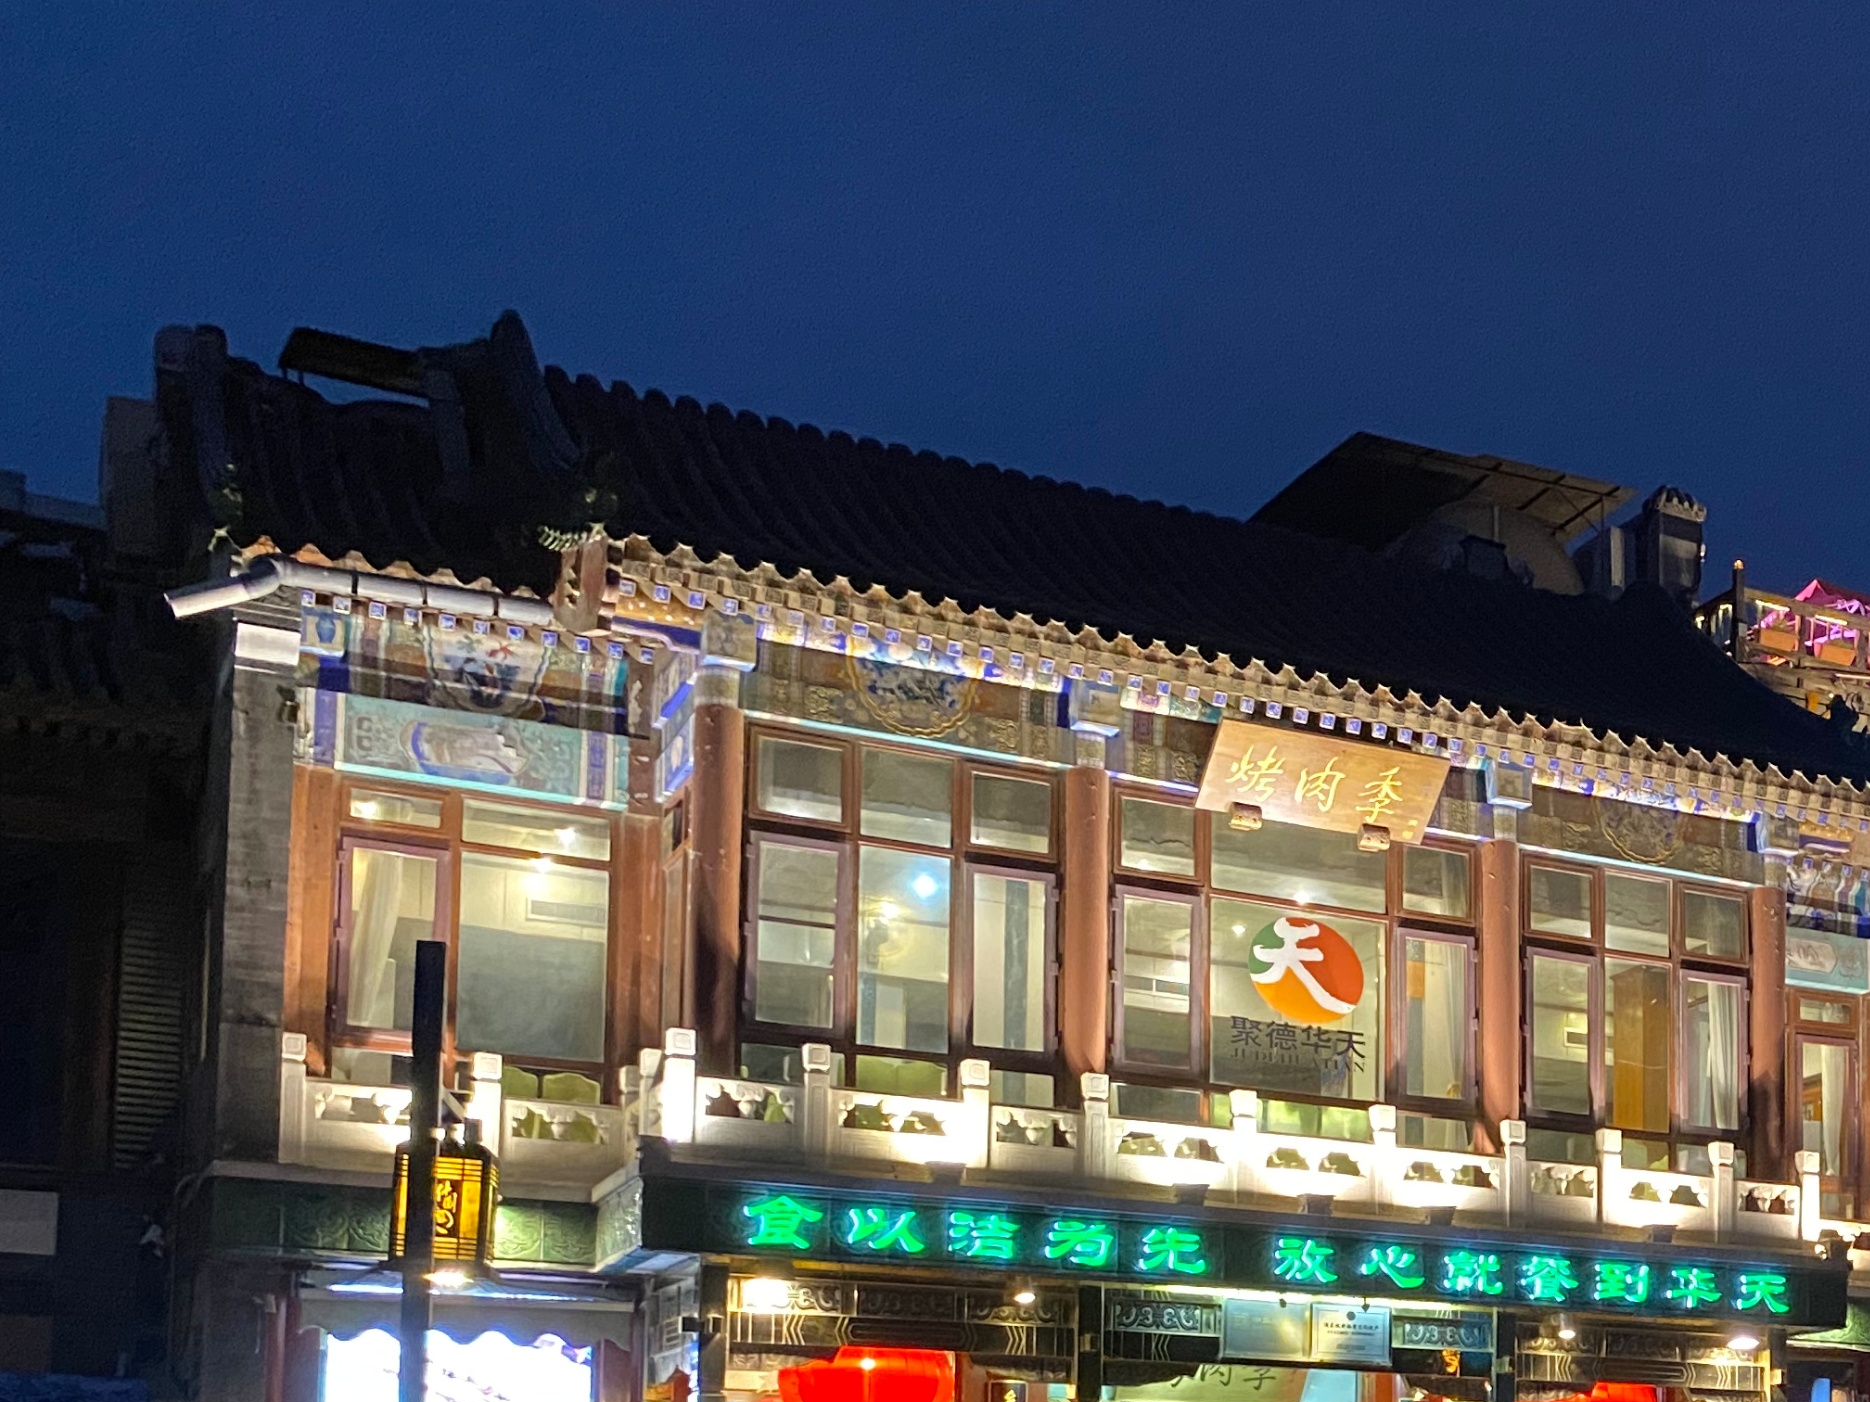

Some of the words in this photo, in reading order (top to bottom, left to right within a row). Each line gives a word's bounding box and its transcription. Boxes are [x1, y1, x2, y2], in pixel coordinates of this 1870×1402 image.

[1225, 744, 1404, 823] 烤肉季
[1230, 1015, 1366, 1059] 聚德华天
[743, 1195, 1206, 1275] 食以洁为先
[1273, 1238, 1791, 1313] 放心就餐到华天
